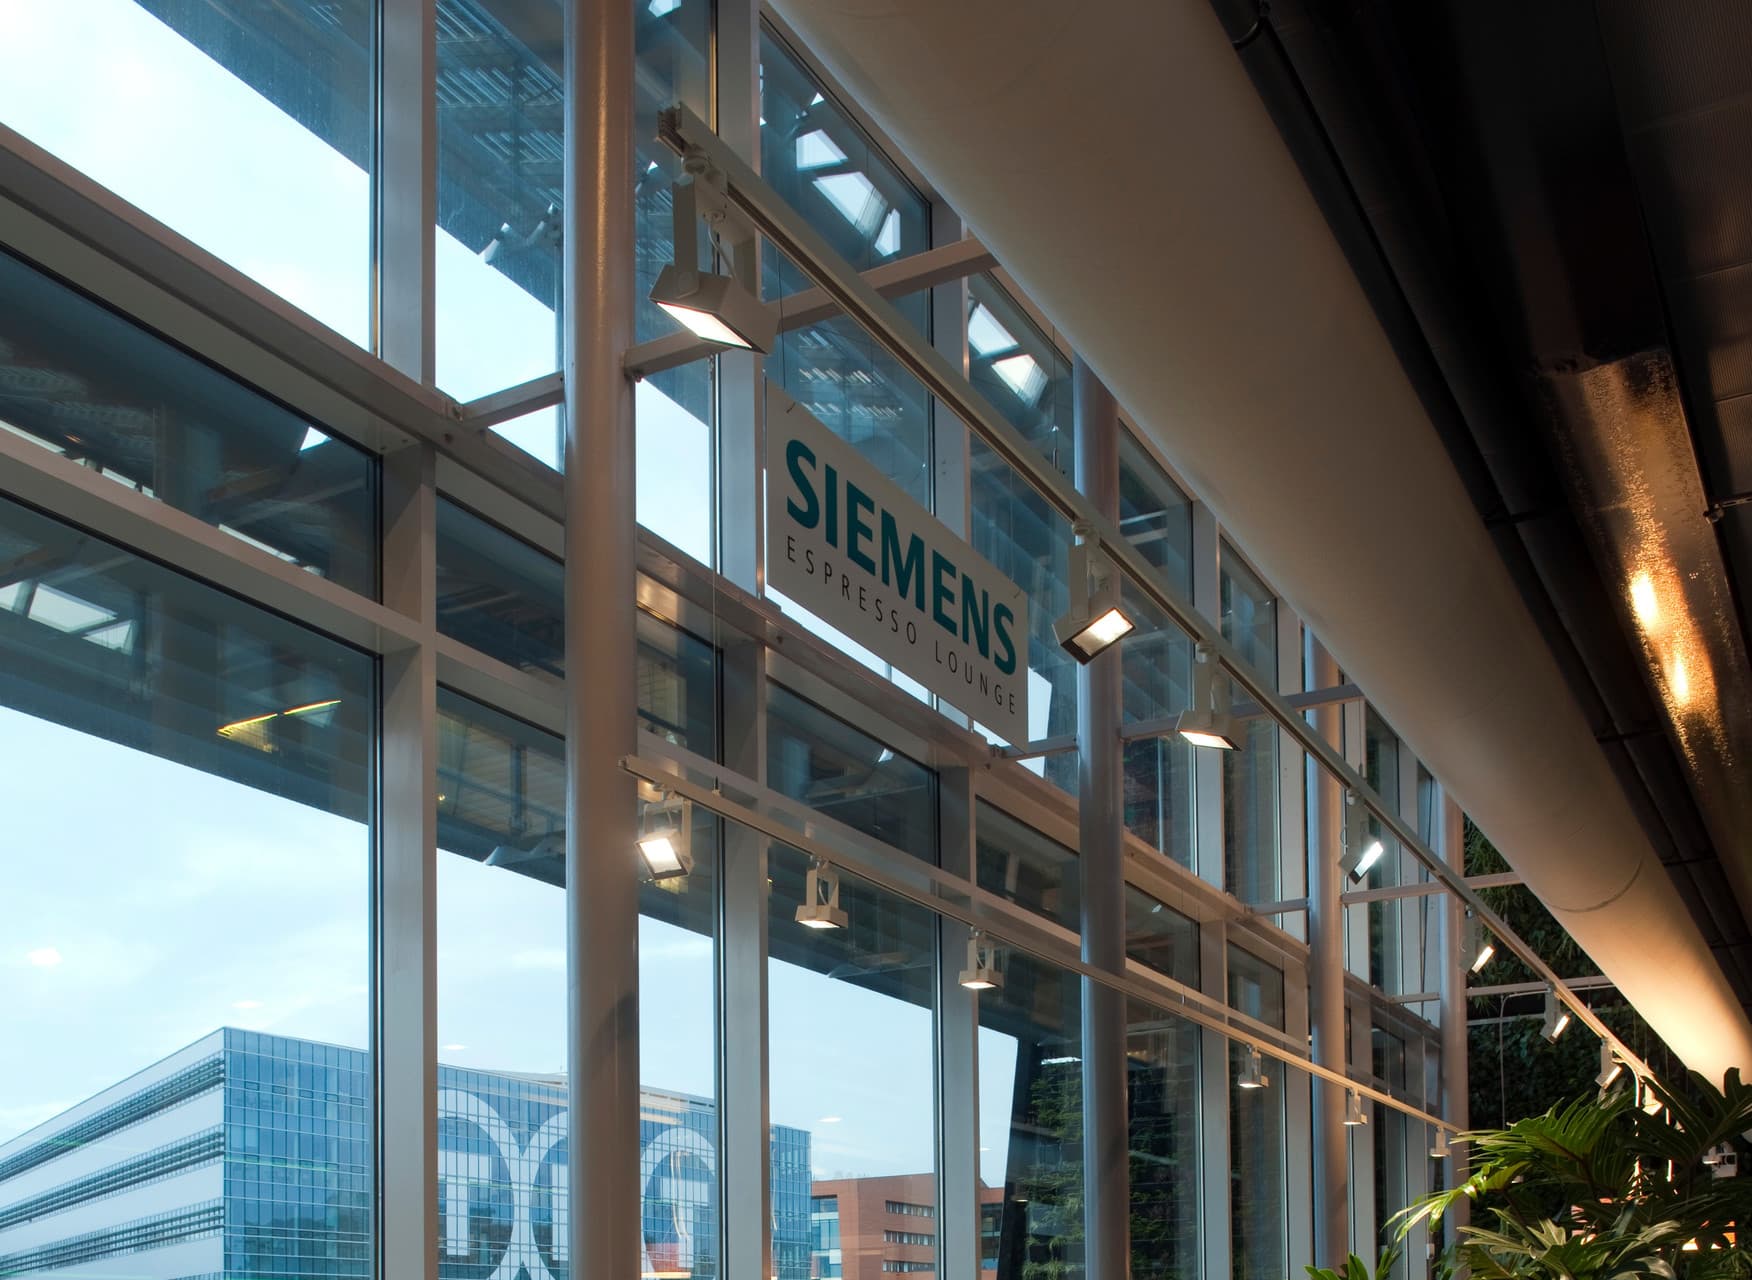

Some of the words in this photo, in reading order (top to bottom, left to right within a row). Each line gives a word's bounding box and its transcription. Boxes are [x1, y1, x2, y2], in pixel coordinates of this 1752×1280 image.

[786, 439, 1017, 676] SIEMENS
[786, 535, 917, 645] ESPRESSO
[935, 640, 1016, 715] LOUNGE
